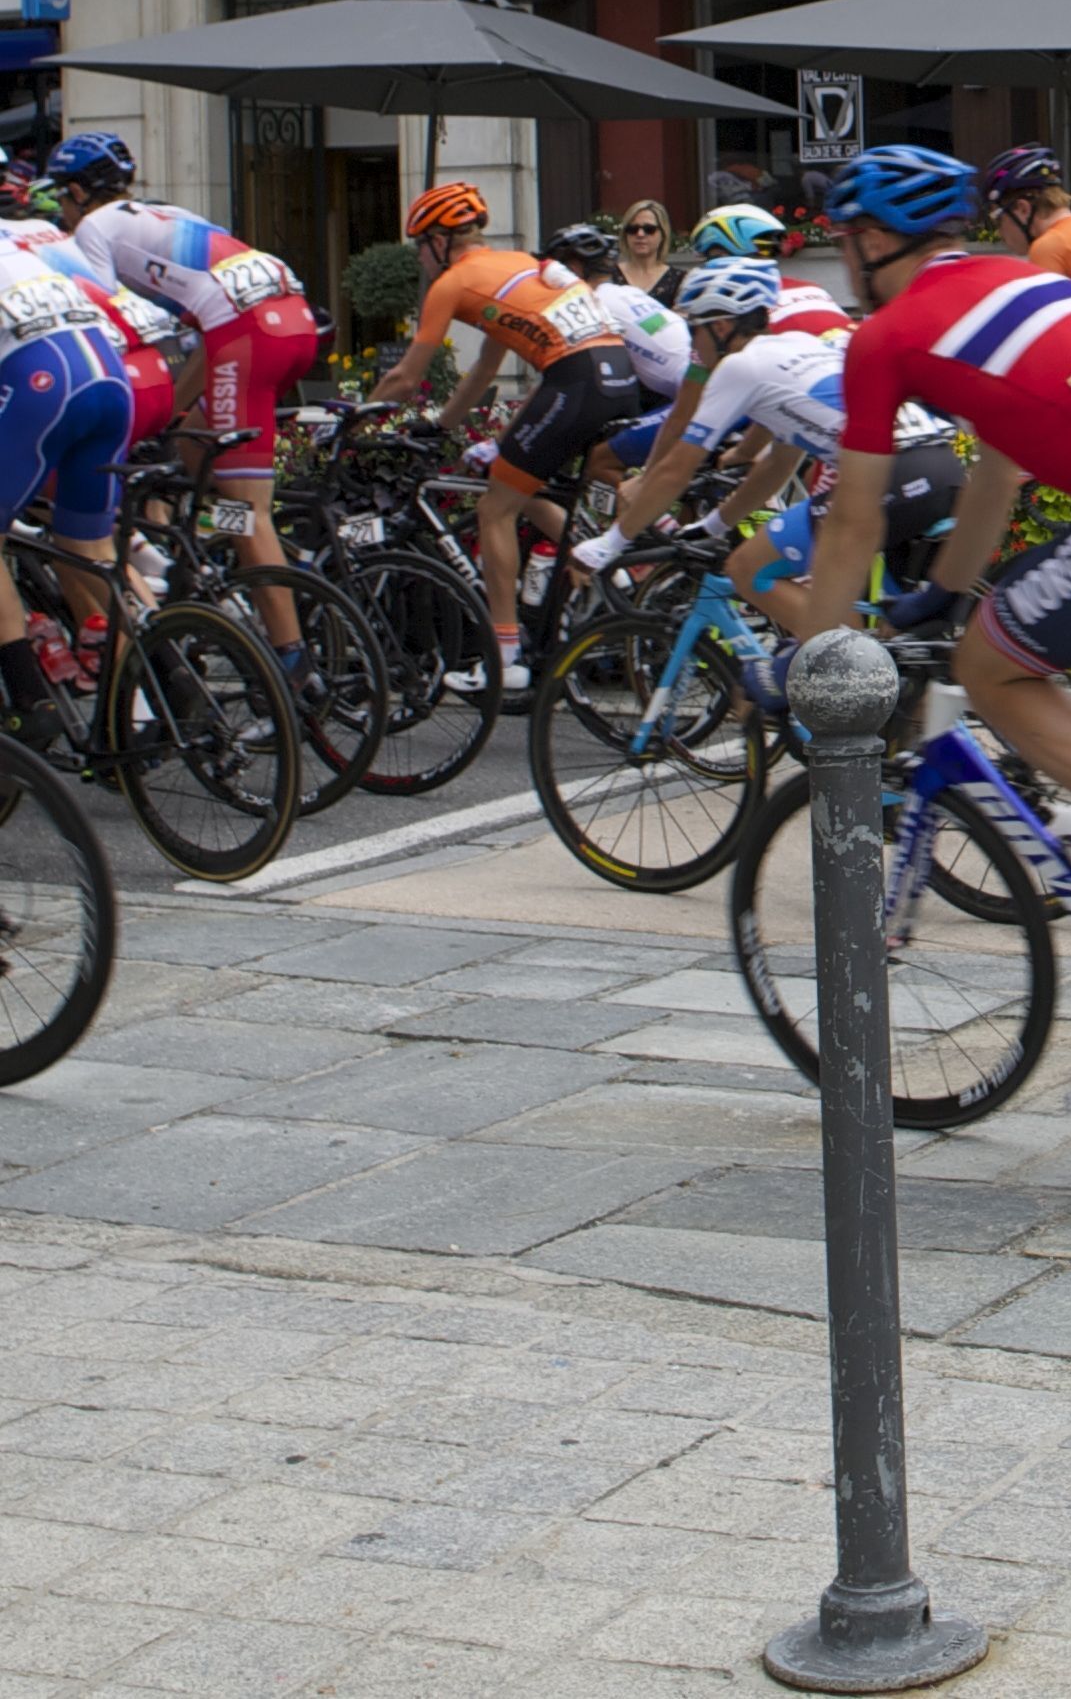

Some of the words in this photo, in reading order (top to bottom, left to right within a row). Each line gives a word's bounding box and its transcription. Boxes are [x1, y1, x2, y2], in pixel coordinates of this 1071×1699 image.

[223, 259, 277, 295] 221
[553, 296, 598, 330] 181
[217, 508, 248, 533] 223
